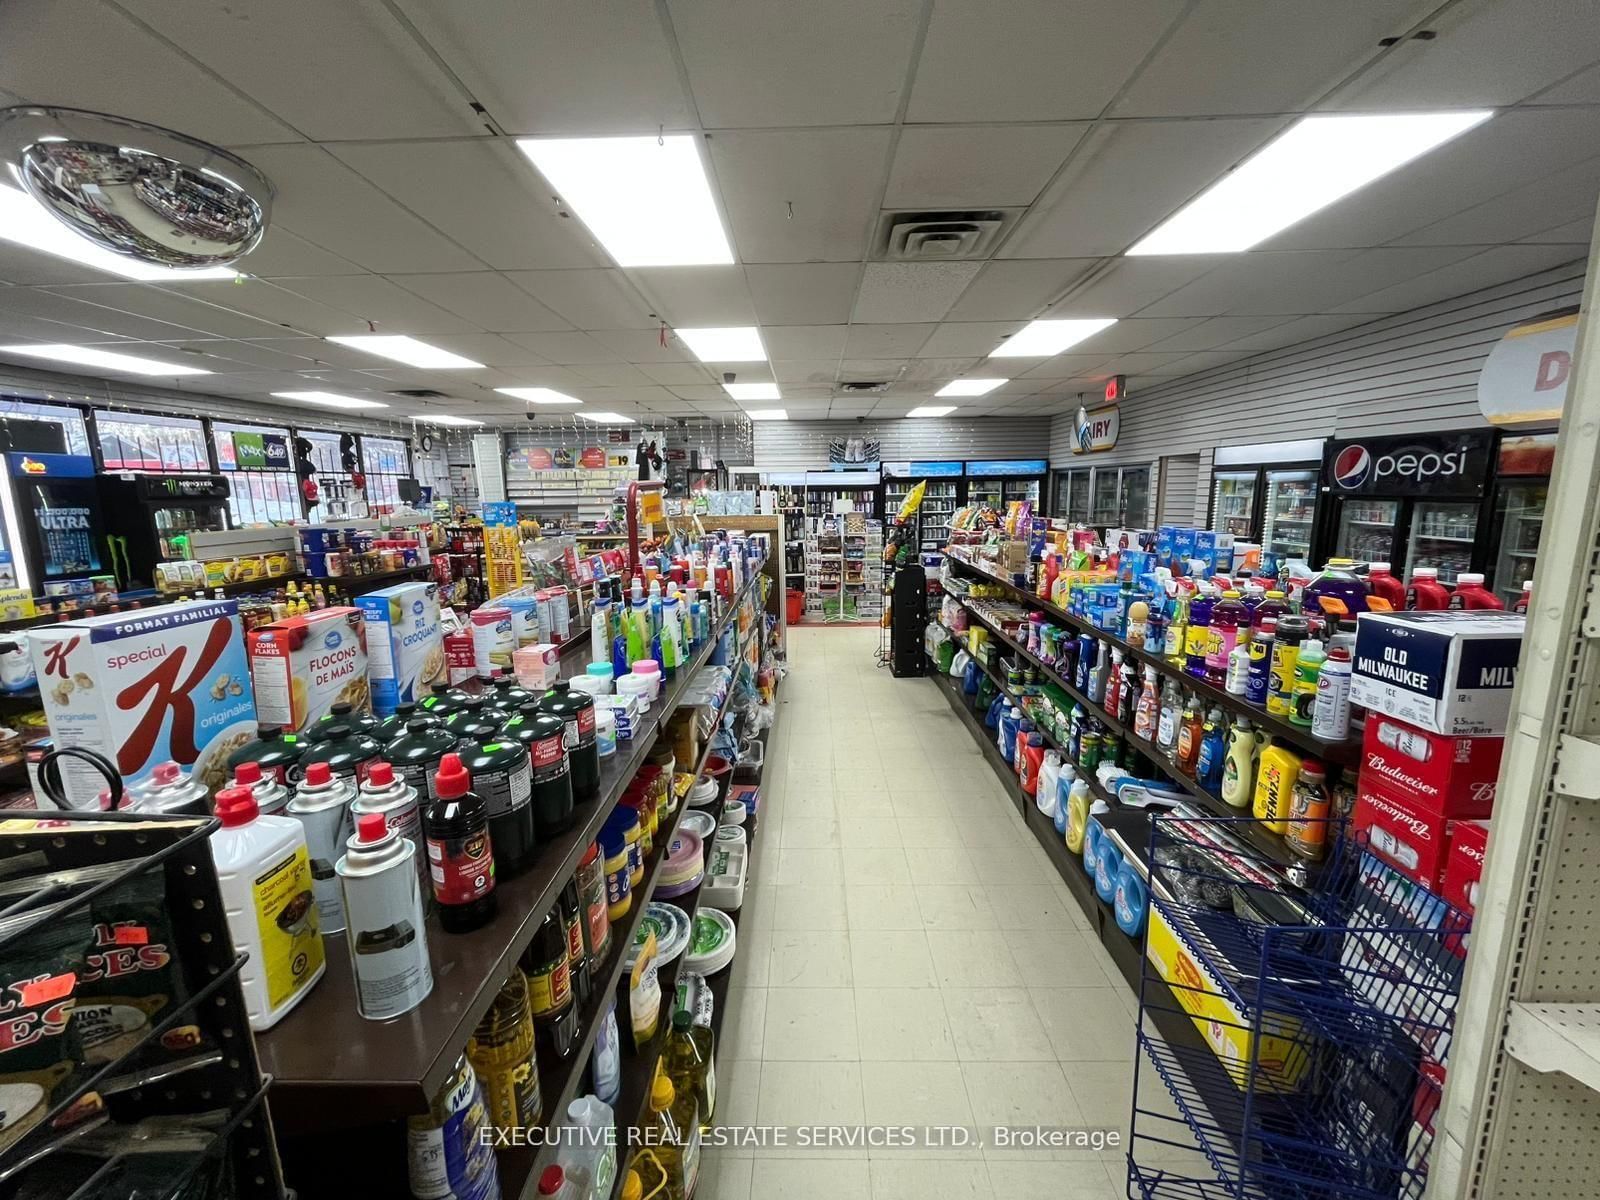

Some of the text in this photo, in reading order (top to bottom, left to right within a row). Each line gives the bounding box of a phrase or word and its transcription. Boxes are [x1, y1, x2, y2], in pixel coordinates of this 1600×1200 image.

[1093, 419, 1111, 439] IRY
[267, 443, 284, 458] 649
[618, 456, 628, 465] 19
[1374, 446, 1467, 481] pepsi
[40, 516, 90, 529] ULTRA
[116, 606, 228, 635] FORMAT FAMILIAL
[415, 617, 425, 629] RIZ
[402, 623, 437, 647] CROQUANT
[44, 634, 80, 679] K
[107, 644, 167, 669] special
[309, 646, 356, 673] FLOCONS
[1384, 646, 1408, 666] OLD
[316, 660, 354, 686] DE MAÏS
[1358, 656, 1429, 690] MILWAUKEE
[116, 617, 233, 776] K
[1385, 687, 1398, 698] ICE
[1458, 694, 1467, 703] 12
[56, 713, 97, 723] originales
[201, 702, 253, 729] originales
[1463, 740, 1472, 750] 12
[1367, 752, 1438, 796] Budweiser
[1361, 794, 1431, 841] Budweiser
